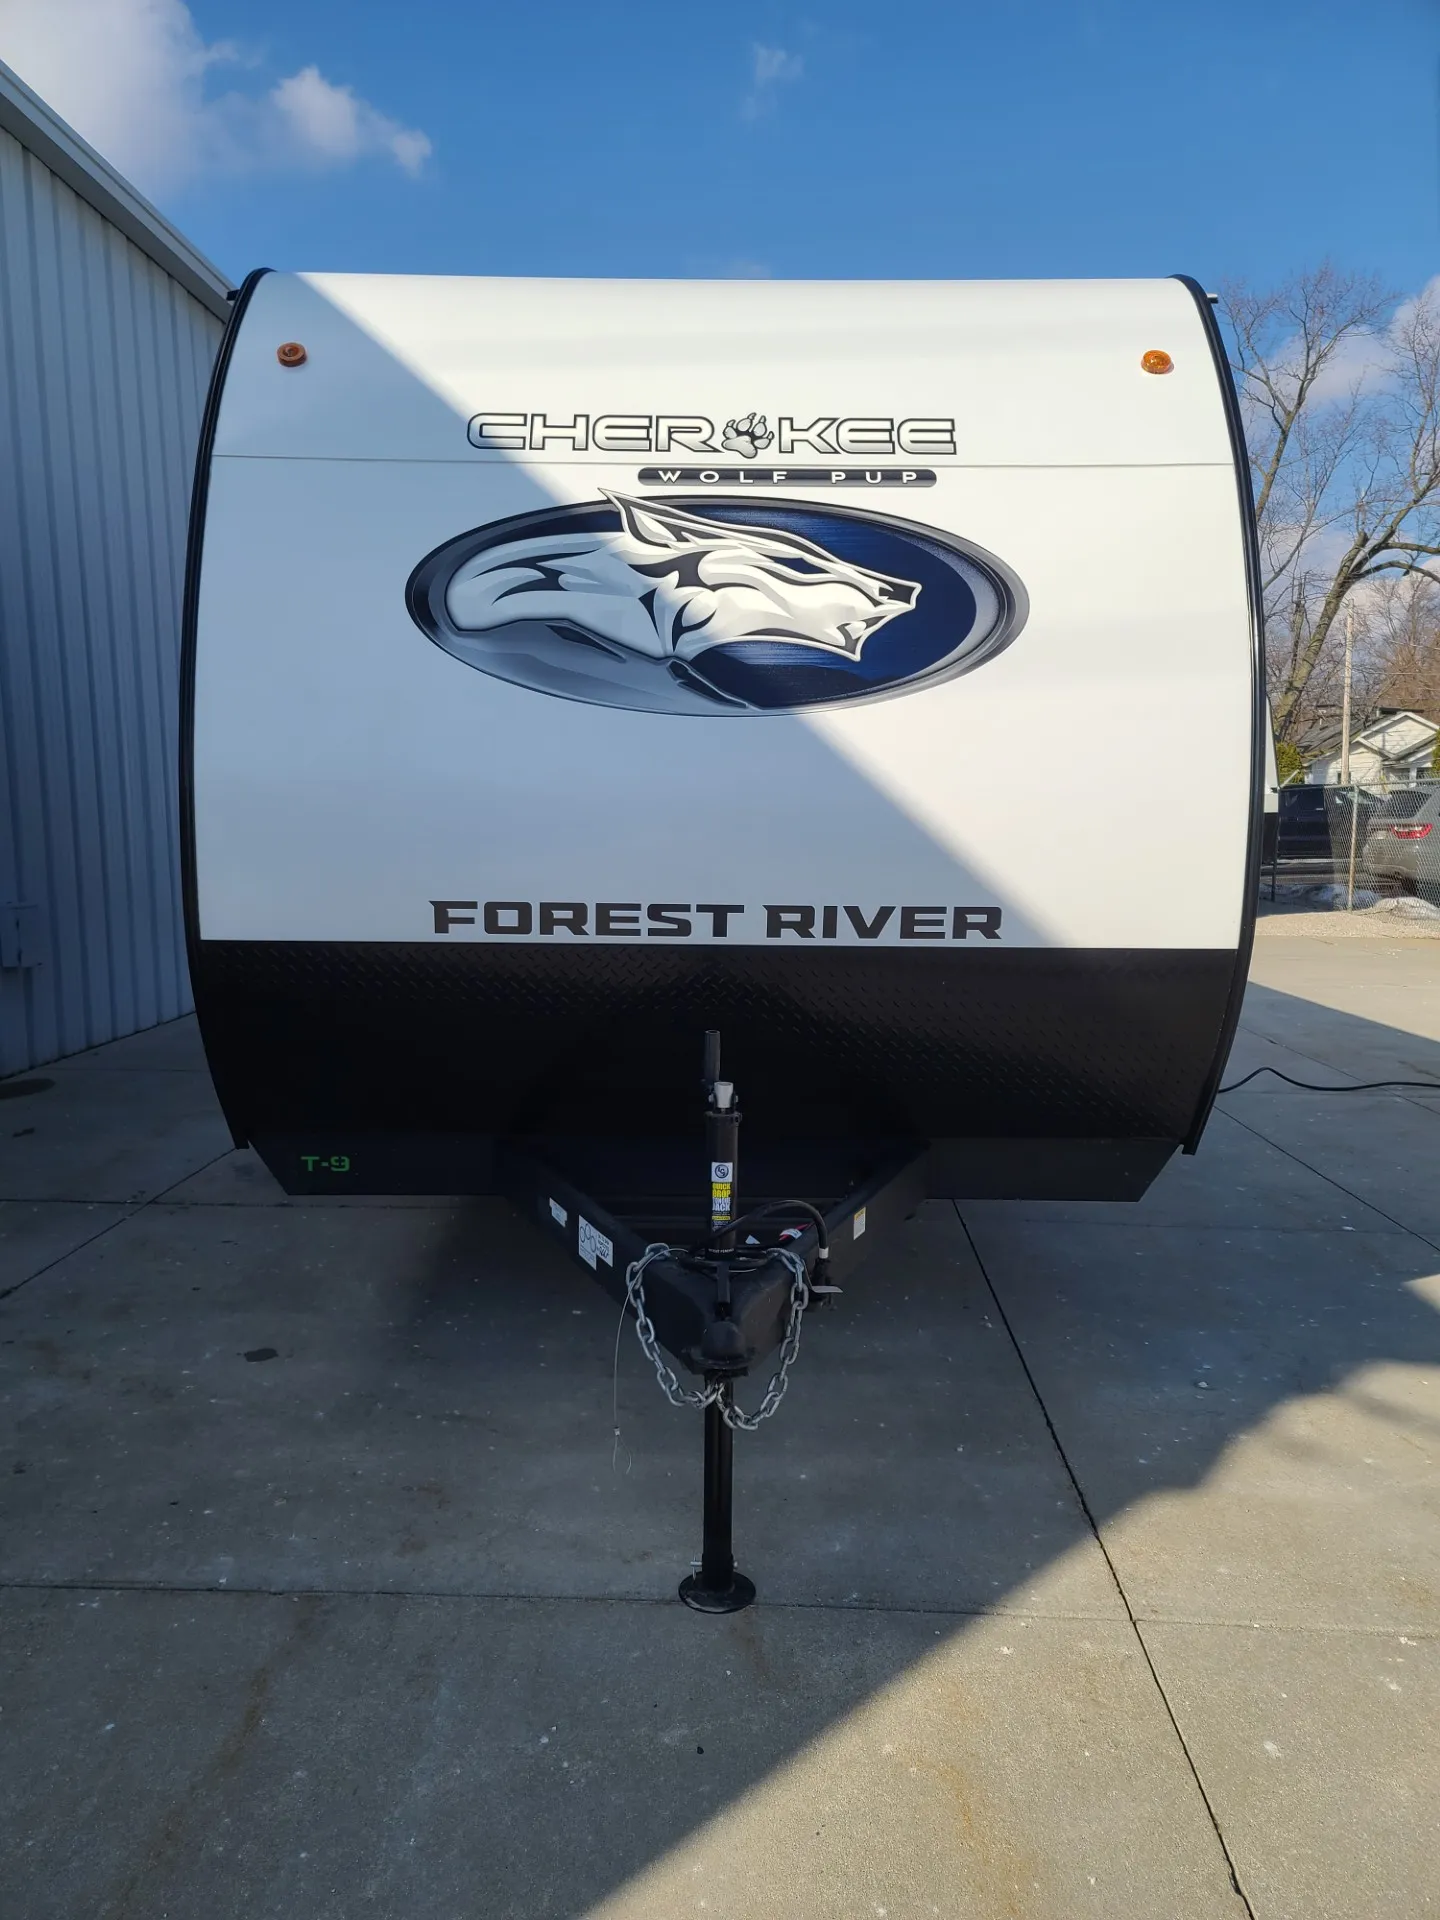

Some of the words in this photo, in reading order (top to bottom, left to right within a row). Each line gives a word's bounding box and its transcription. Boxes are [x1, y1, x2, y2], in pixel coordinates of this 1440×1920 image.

[657, 470, 789, 484] WOLF
[831, 471, 918, 485] PUP
[428, 900, 745, 938] FOREST
[763, 904, 1003, 940] RIVER
[300, 1156, 350, 1172] T-9
[712, 1189, 731, 1198] DROP
[712, 1203, 731, 1211] JACK
